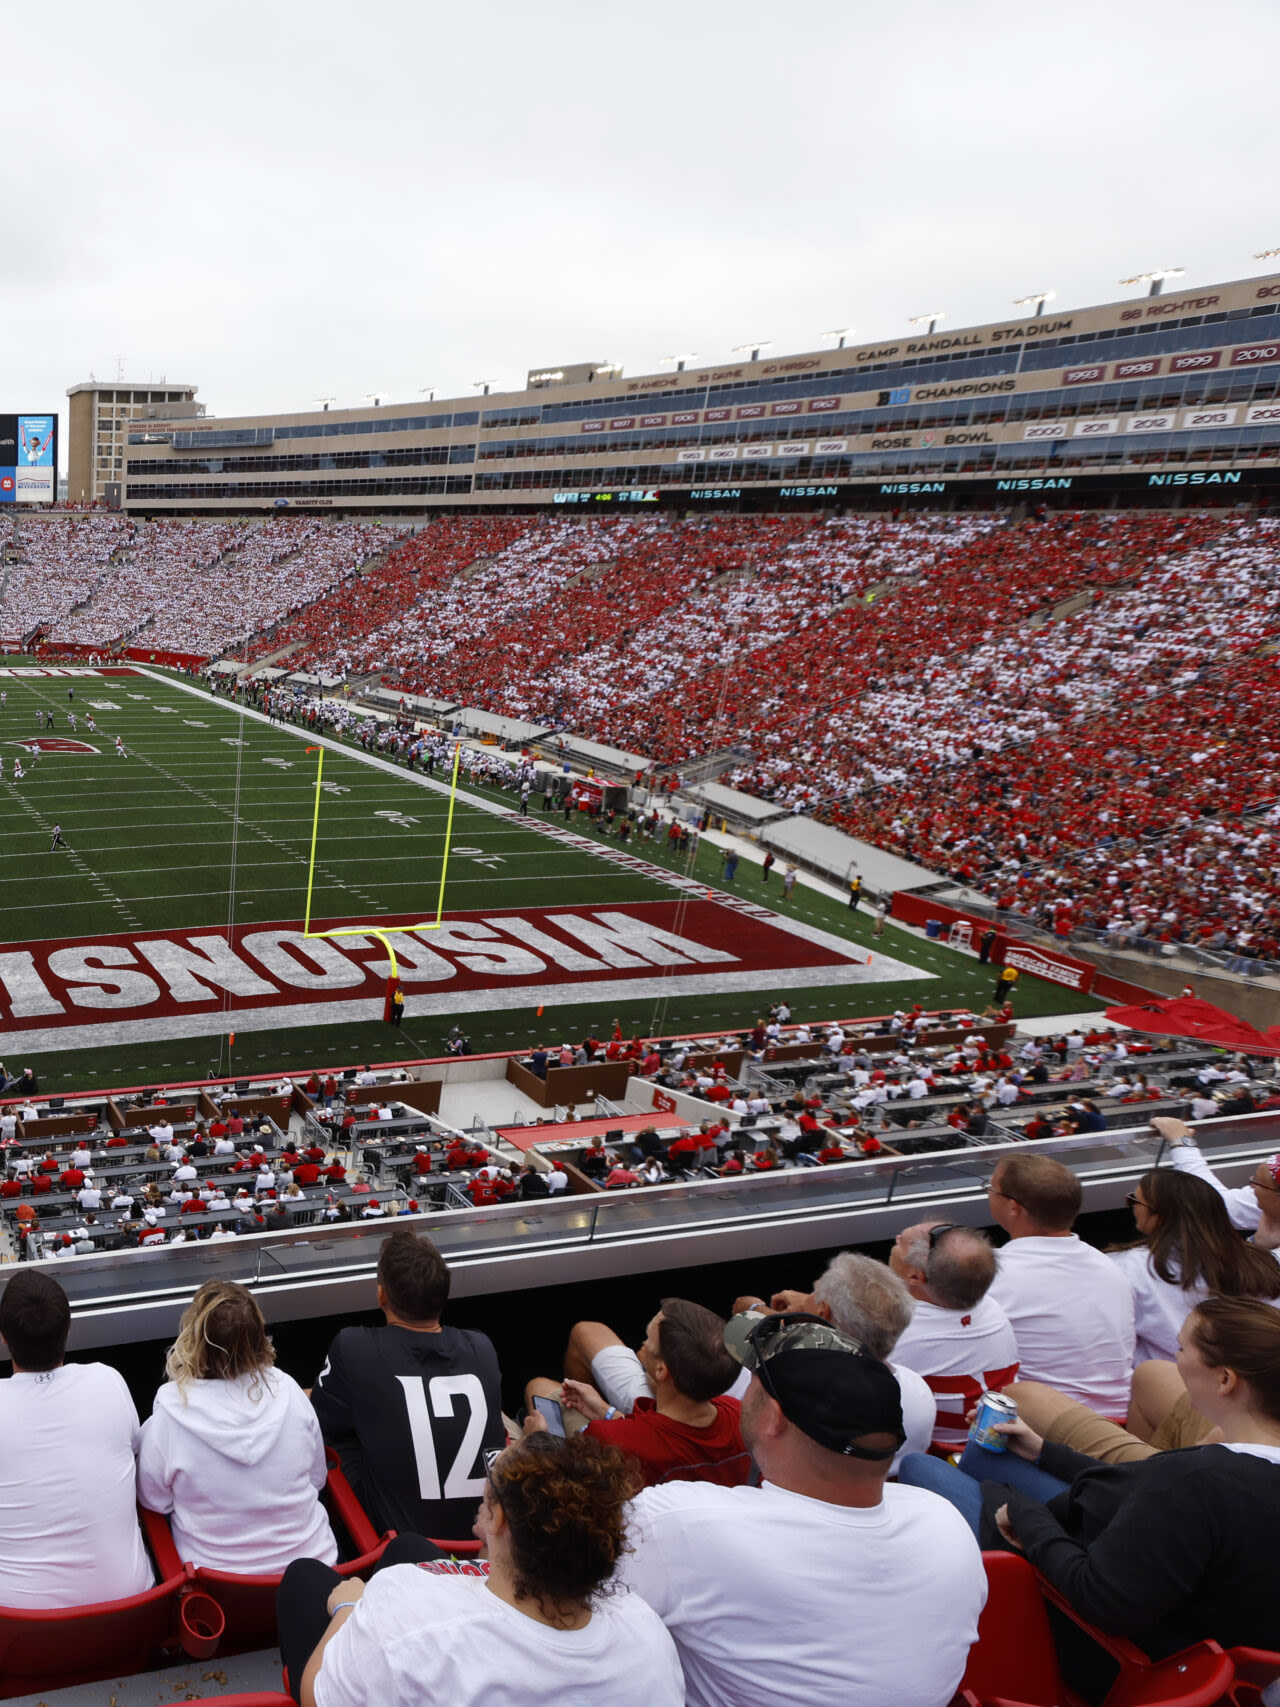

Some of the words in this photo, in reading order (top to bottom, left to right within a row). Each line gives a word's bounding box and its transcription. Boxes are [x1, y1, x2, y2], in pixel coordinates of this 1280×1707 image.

[1120, 309, 1141, 320] 88
[1146, 296, 1220, 317] RICHTER
[856, 347, 899, 361] CAMP
[906, 335, 982, 353] RANDALL
[992, 320, 1072, 341] STADIUM
[1235, 347, 1277, 361] 2010
[779, 360, 821, 372] HIRSCH
[1176, 355, 1214, 368] 1999
[712, 369, 743, 381] DAYNE
[1120, 363, 1153, 375] 1998
[1068, 369, 1099, 382] 1993
[915, 380, 1016, 400] CHAMPIONS
[812, 400, 836, 409] 1962
[1134, 418, 1167, 429] 2012
[1192, 413, 1227, 424] 2013
[1026, 426, 1063, 437] 2000
[1082, 423, 1109, 433] 2011
[872, 438, 912, 449] ROSE
[944, 432, 993, 444] BOWL
[996, 478, 1072, 490] NISSAN
[1148, 472, 1241, 486] NISSAN
[691, 489, 741, 498] NISSAN
[780, 487, 838, 496] NISSAN
[880, 483, 945, 494] NISSAN
[595, 493, 612, 501] 4:06
[373, 810, 421, 825] 20
[451, 847, 507, 864] 10
[500, 813, 576, 837] BARRY
[566, 840, 686, 881] ALVAREZ
[681, 885, 780, 918] FIELD
[1006, 951, 1049, 969] AMERICAN
[1049, 965, 1081, 980] FAMILY
[395, 1373, 488, 1500] 12
